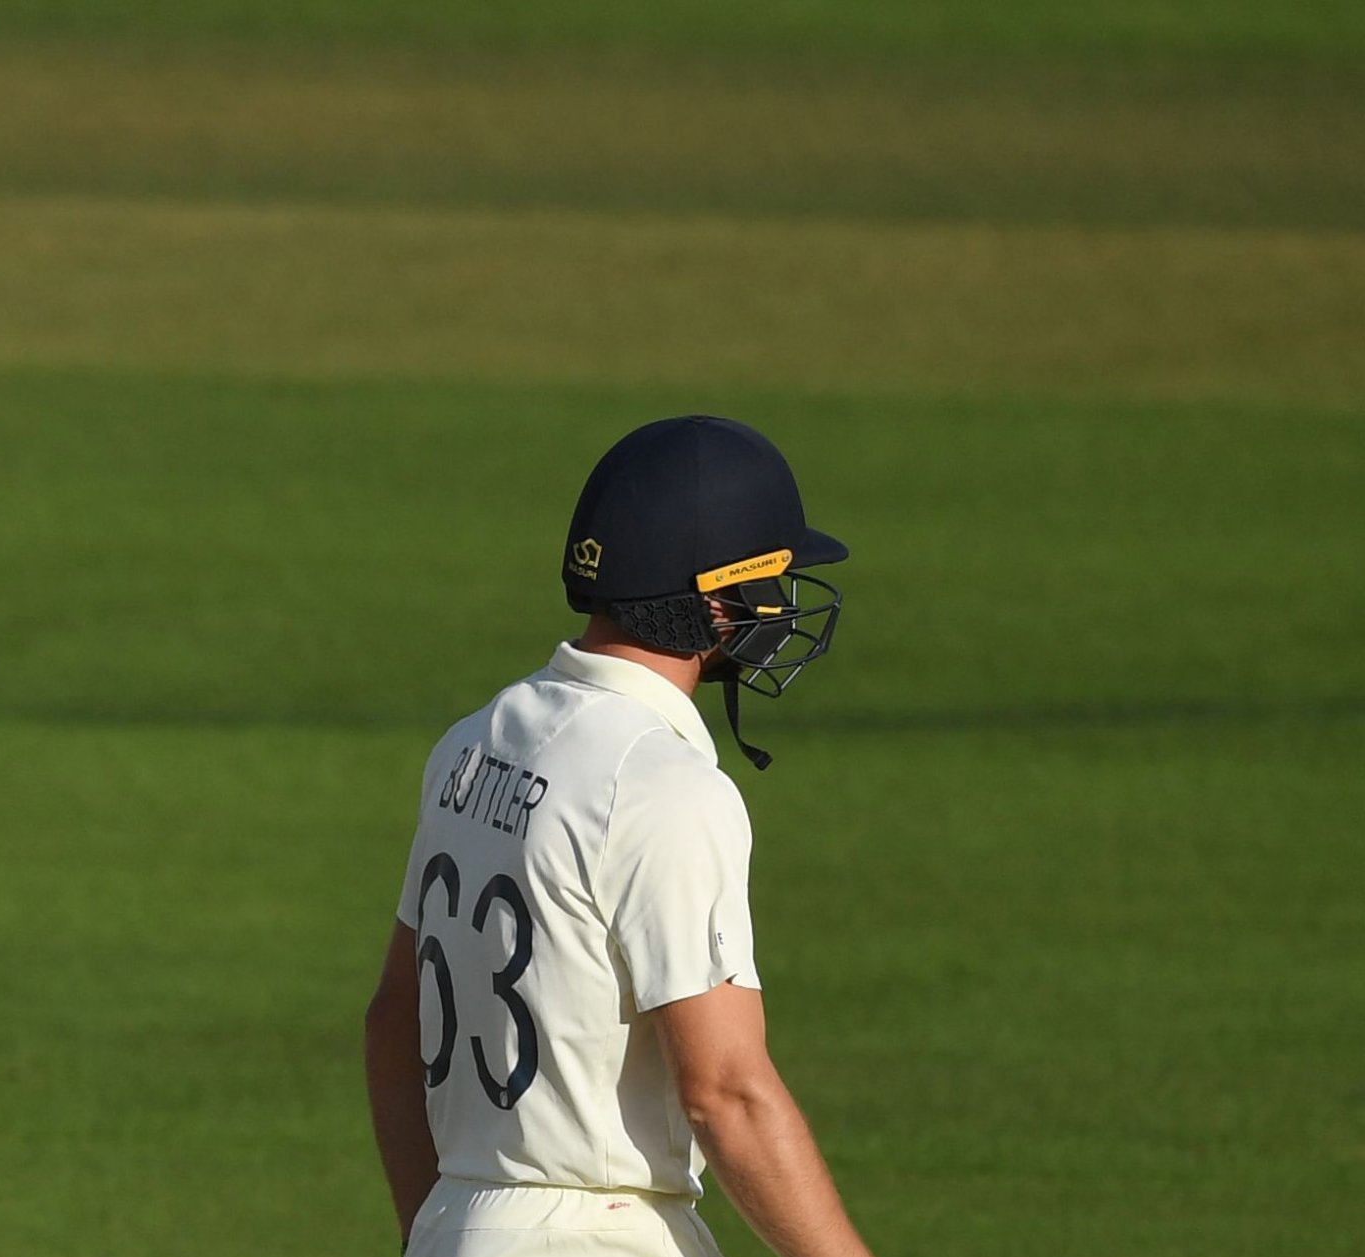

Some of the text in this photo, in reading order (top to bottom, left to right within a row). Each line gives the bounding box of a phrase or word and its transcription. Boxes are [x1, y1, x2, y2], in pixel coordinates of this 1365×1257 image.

[729, 557, 778, 577] MASURI
[439, 746, 549, 840] BUTTLER
[416, 852, 539, 1111] 63
